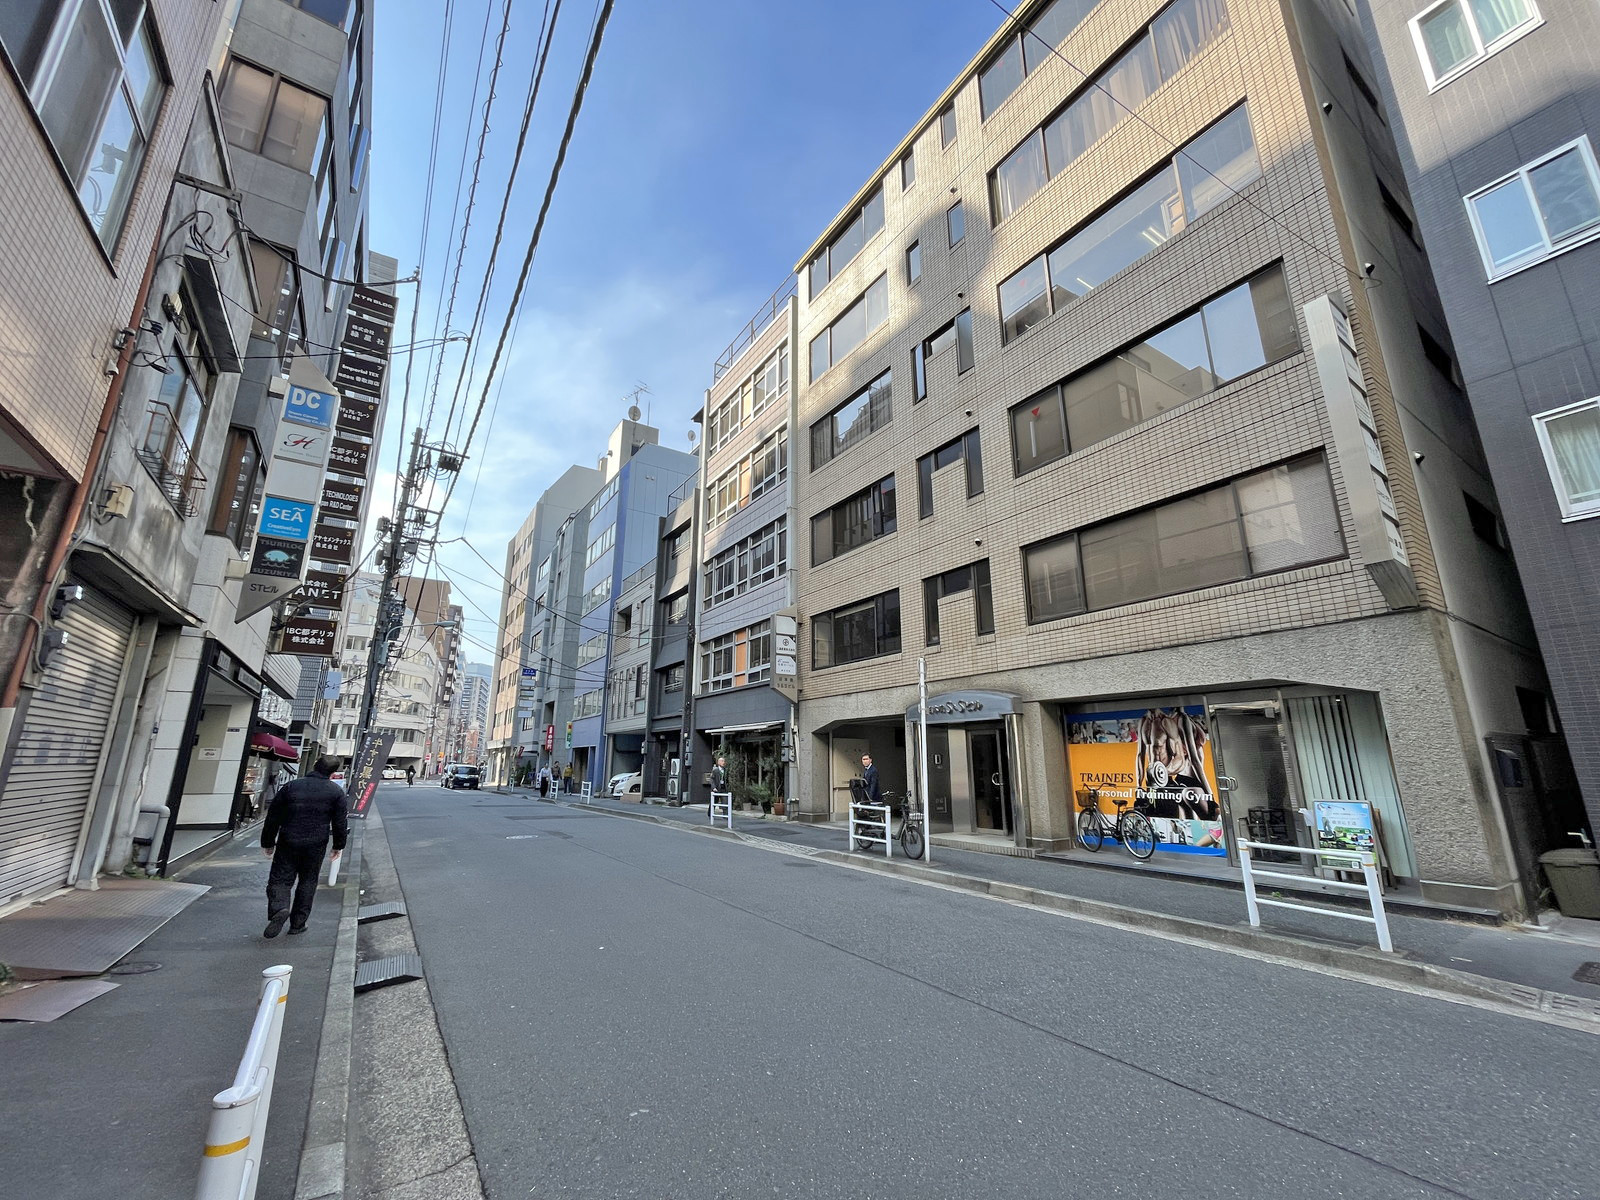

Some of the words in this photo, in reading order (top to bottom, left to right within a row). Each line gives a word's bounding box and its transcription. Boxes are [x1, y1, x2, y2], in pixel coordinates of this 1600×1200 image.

[291, 388, 321, 409] DC
[250, 583, 279, 594] STビル
[305, 580, 329, 589] 式会社
[291, 635, 326, 646] 株式会社
[1080, 773, 1134, 783] TRAINEES
[1092, 787, 1132, 798] ersonal
[1135, 788, 1182, 803] Training
[1185, 790, 1213, 803] Gym
